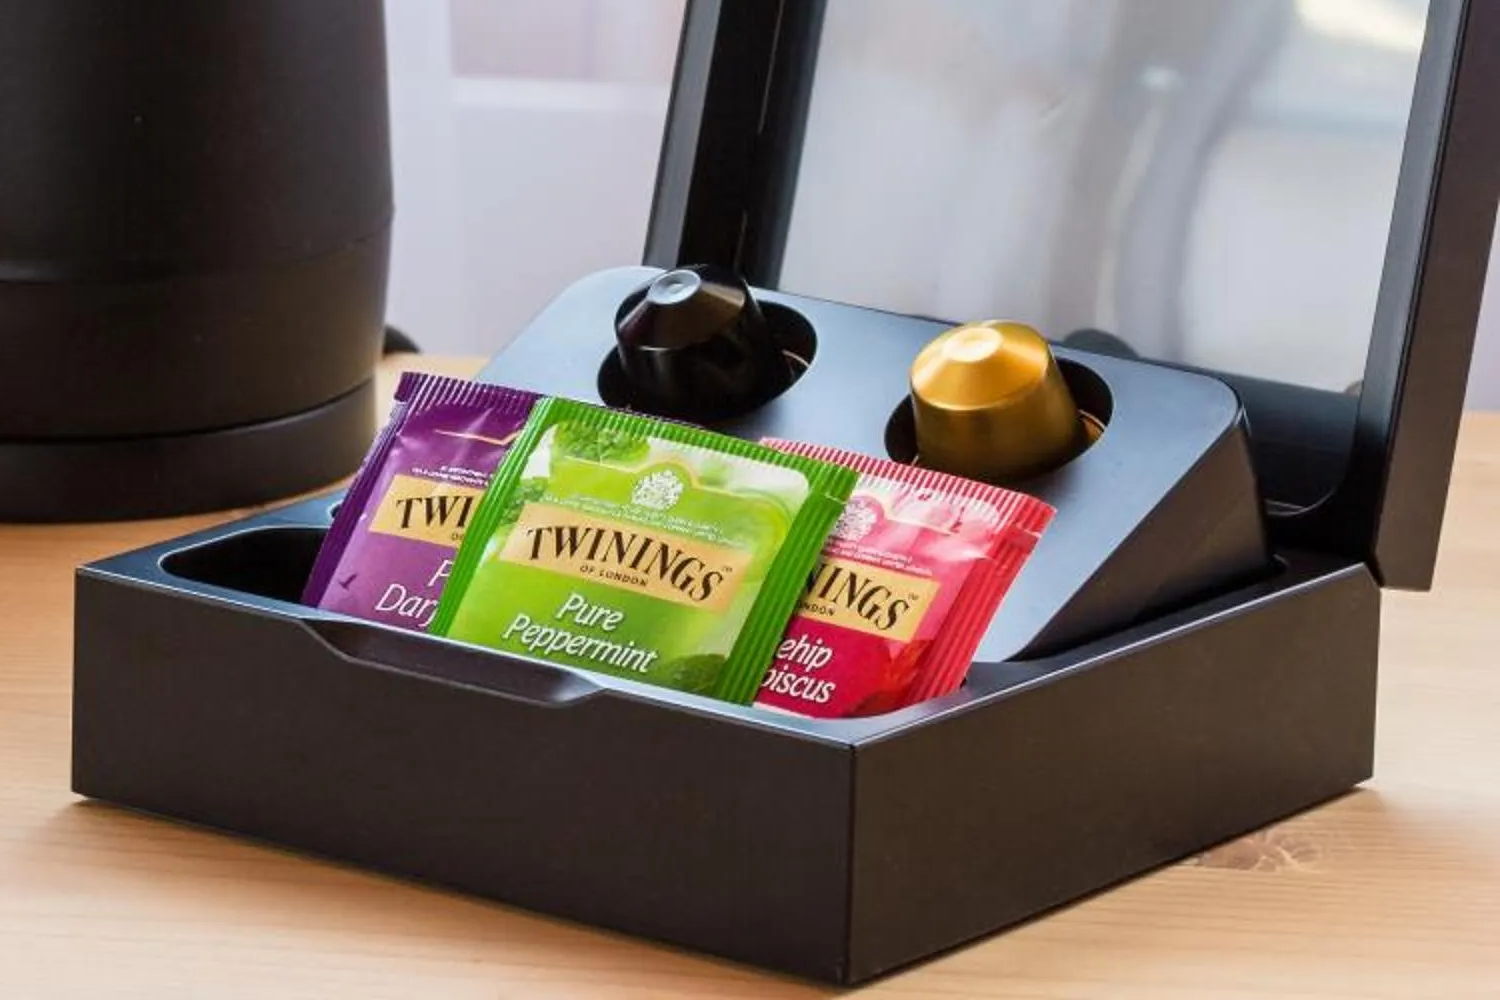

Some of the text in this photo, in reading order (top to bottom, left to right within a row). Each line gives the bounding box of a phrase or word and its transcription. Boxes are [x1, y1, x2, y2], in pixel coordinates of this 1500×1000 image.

[527, 526, 723, 601] TWININGS
[580, 565, 648, 587] OF LONDON
[556, 592, 624, 631] Pure
[502, 613, 658, 672] Peppermint
